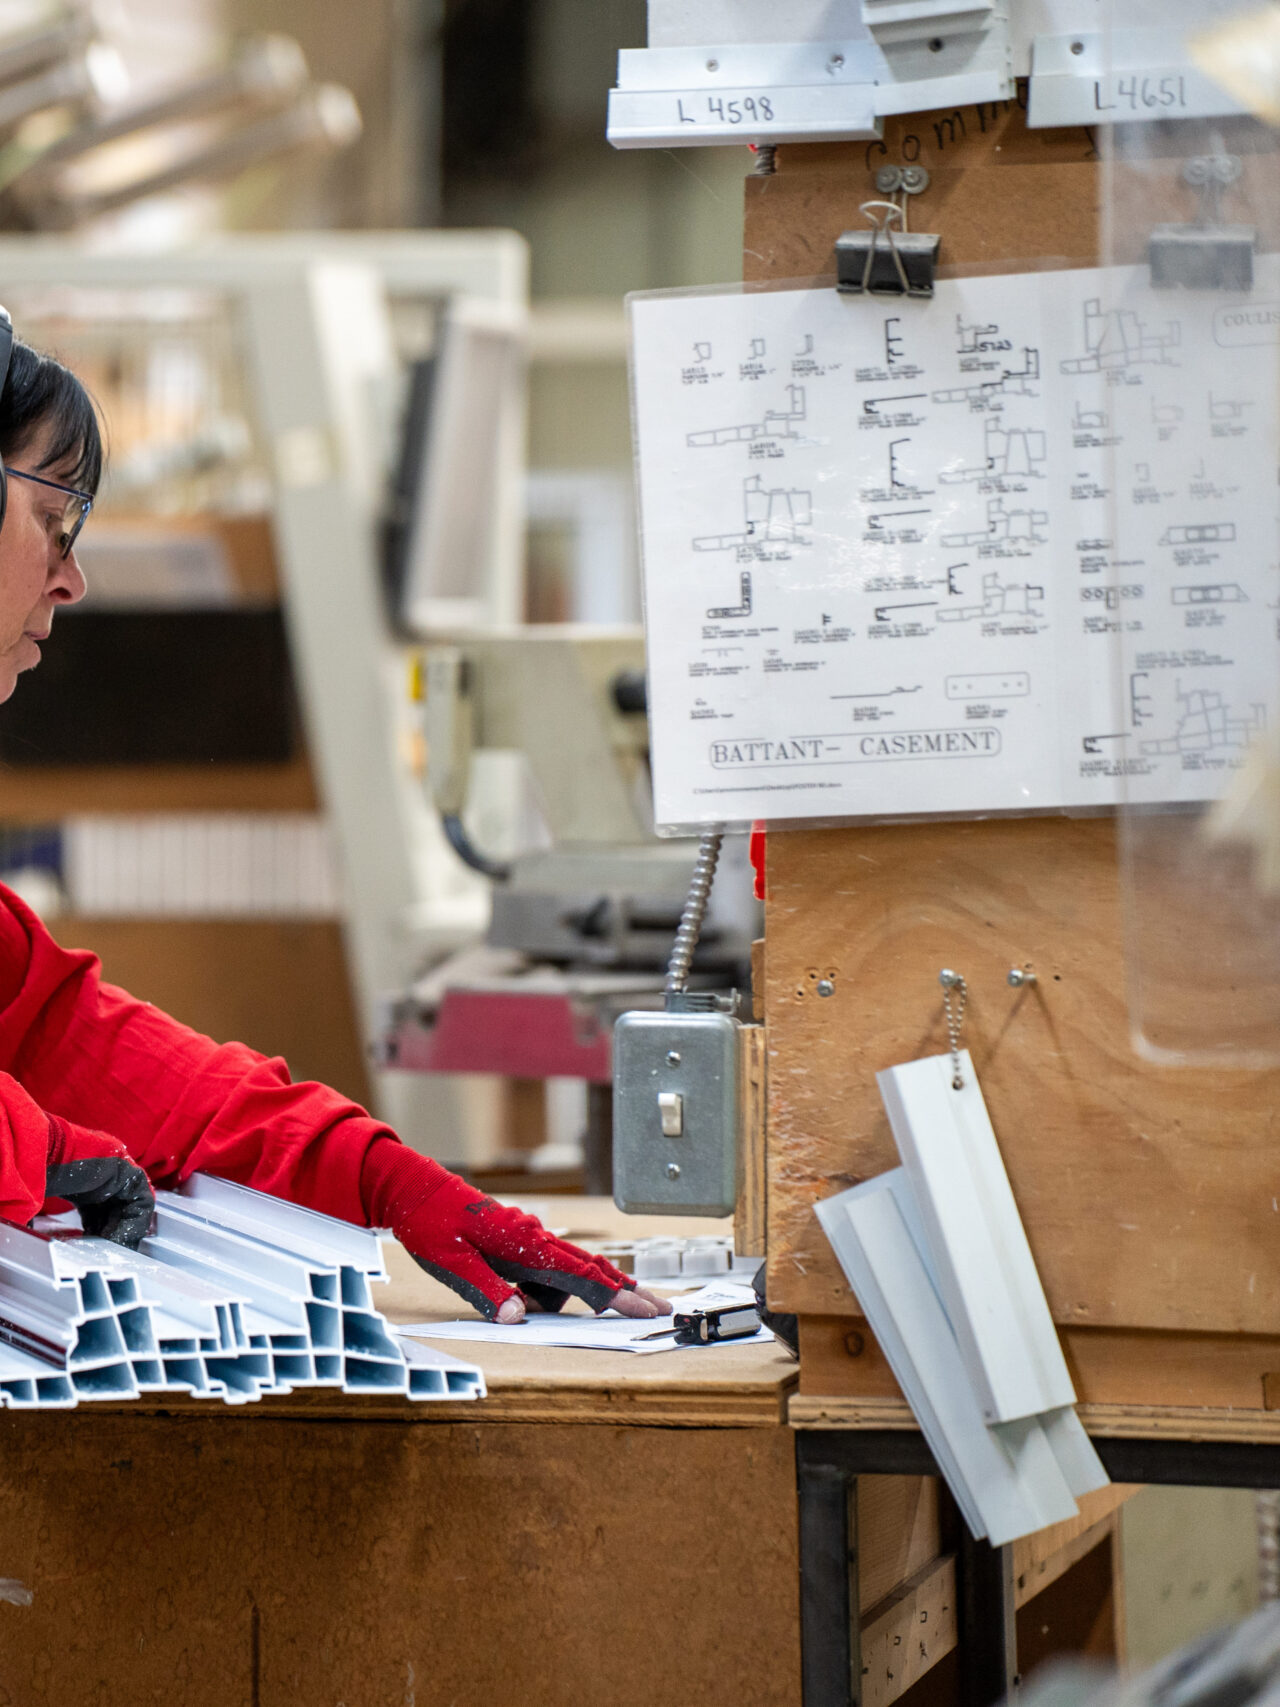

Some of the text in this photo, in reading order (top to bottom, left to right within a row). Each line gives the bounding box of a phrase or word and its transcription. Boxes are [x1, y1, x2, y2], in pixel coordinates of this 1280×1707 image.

[677, 96, 776, 124] L 4598
[859, 731, 996, 757] CASEMENT
